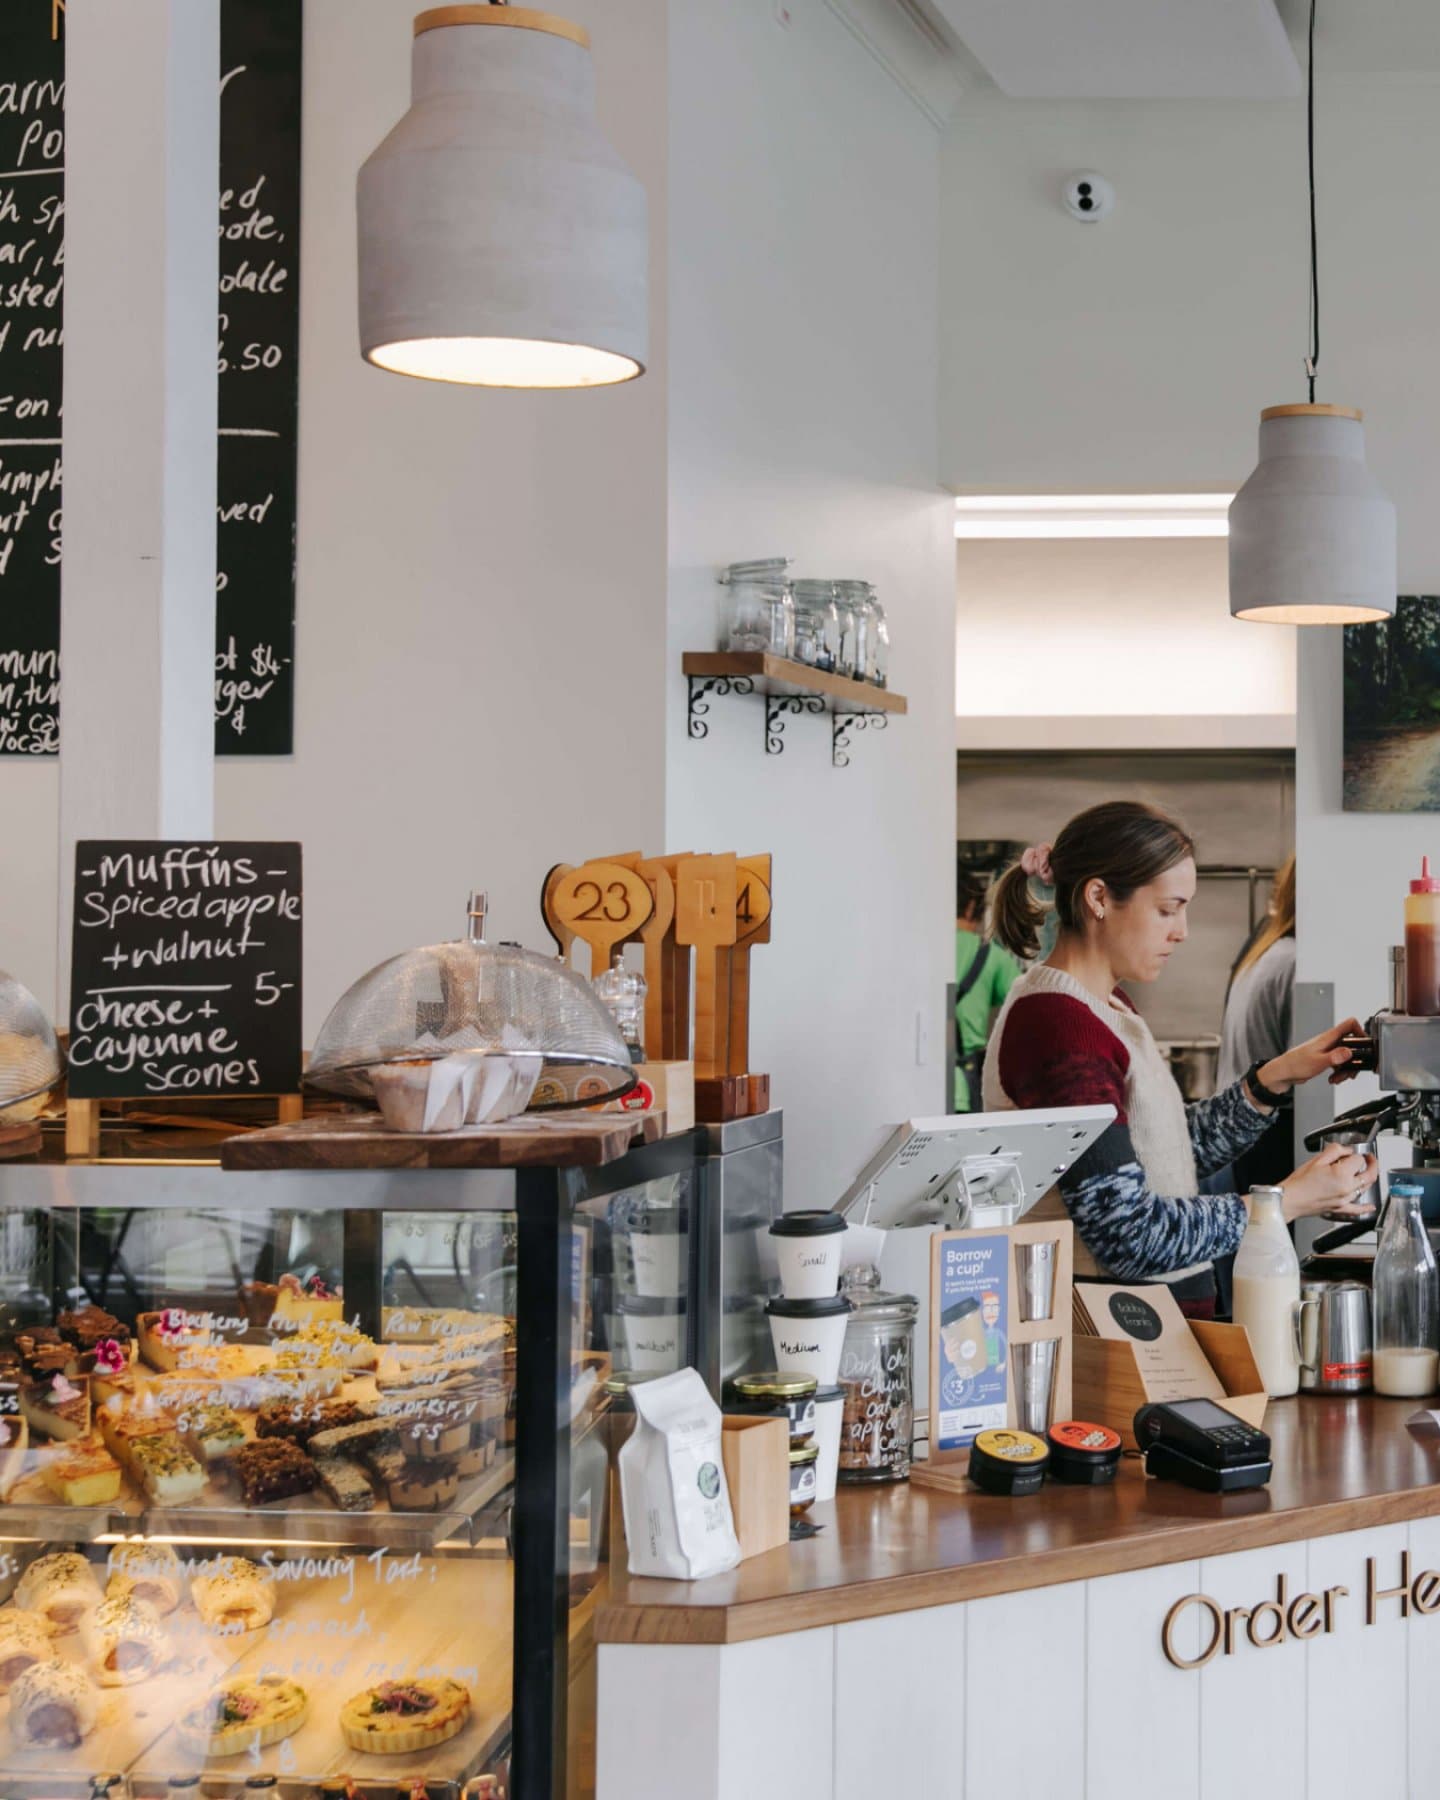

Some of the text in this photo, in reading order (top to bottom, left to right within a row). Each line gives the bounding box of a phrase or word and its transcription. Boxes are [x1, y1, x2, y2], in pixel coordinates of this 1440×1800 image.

[0, 276, 64, 308] sted
[204, 888, 300, 929] apple
[572, 881, 631, 922] 23
[946, 1248, 993, 1264] Borrow
[946, 1261, 984, 1277] a cup!
[780, 1340, 822, 1355] Medium
[262, 1550, 356, 1604] Savoury
[1161, 1572, 1350, 1670] Order
